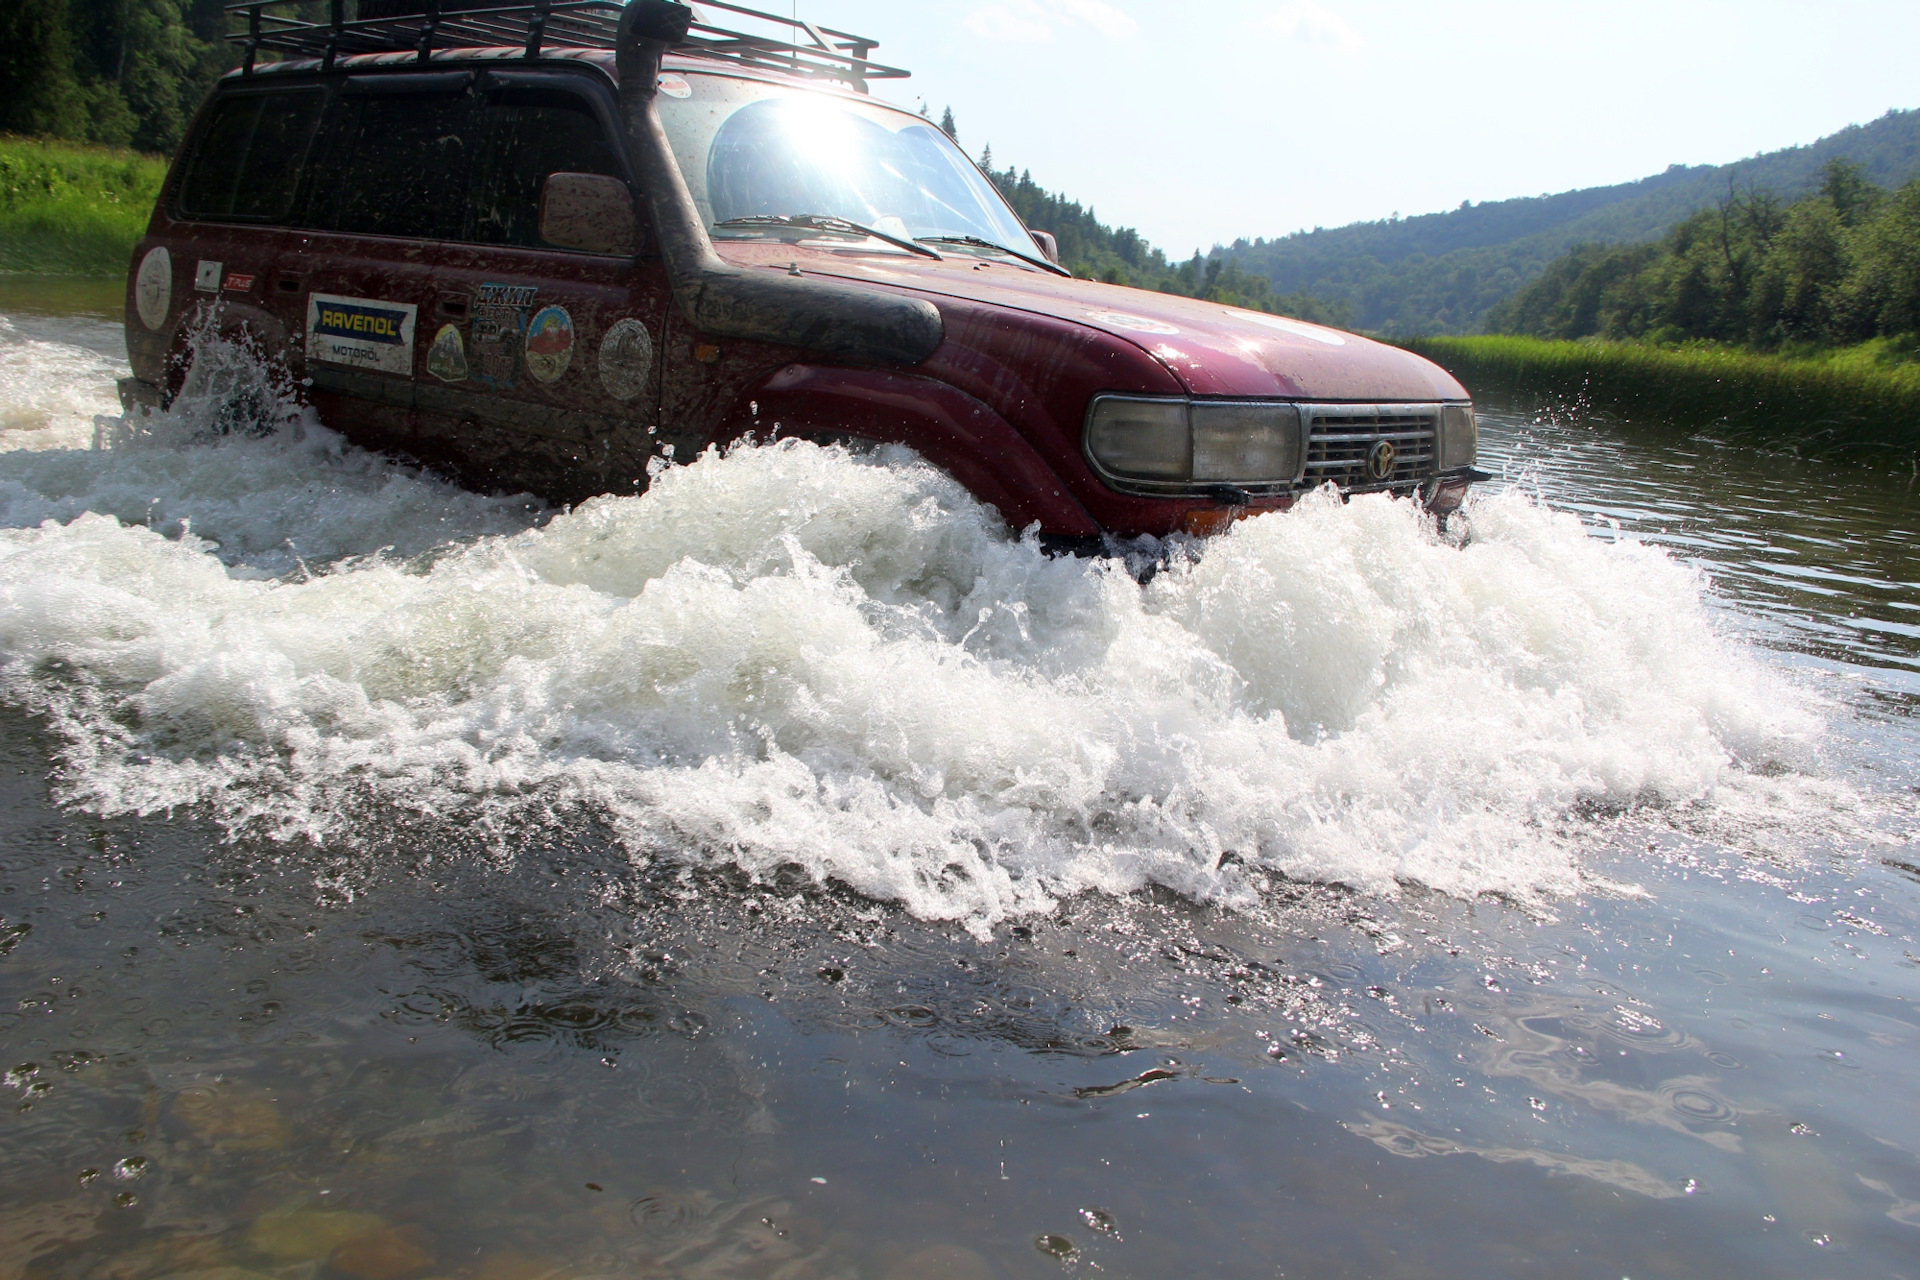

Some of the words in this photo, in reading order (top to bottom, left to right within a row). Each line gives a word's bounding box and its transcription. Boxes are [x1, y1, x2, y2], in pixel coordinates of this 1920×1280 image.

[473, 285, 538, 308] ДЖИП
[322, 310, 396, 337] RAVENOL
[332, 345, 379, 361] MOTORÖL
